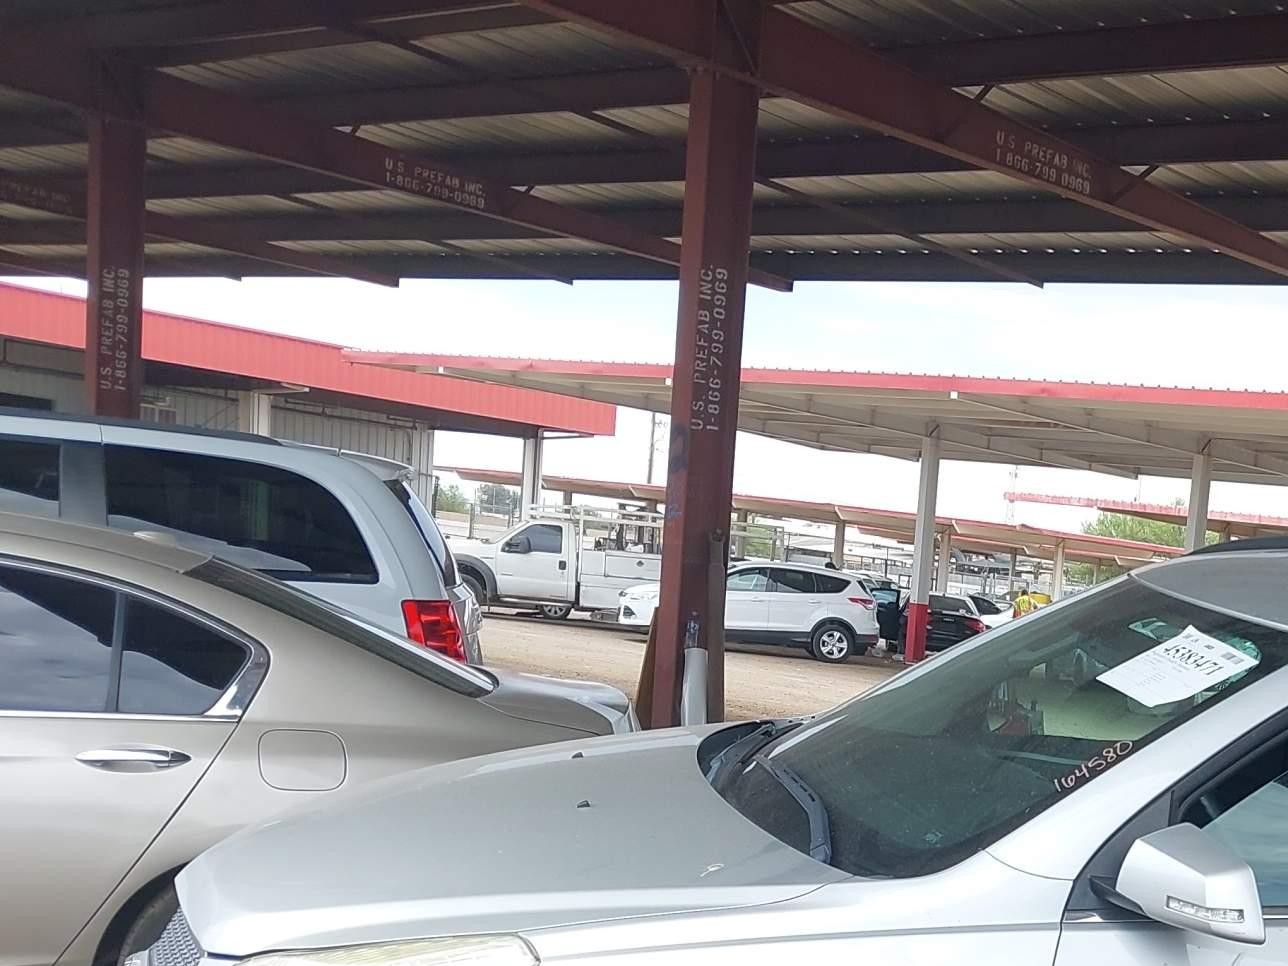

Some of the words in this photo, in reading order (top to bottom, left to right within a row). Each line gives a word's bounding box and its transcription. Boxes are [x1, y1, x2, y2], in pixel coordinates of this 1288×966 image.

[414, 166, 460, 189] PREFAB
[465, 182, 486, 197] INC.
[1024, 142, 1069, 169] PREFAB
[1072, 159, 1092, 179] INC.
[102, 265, 115, 293] INC.
[699, 264, 713, 300] INC.
[100, 299, 115, 355] PREFAB
[113, 268, 130, 391] 1-866-799-0969
[694, 310, 711, 384] PREFAB
[706, 267, 729, 430] 1-866-799-0969
[690, 395, 706, 431] U.S.
[1053, 740, 1133, 792] 164580
